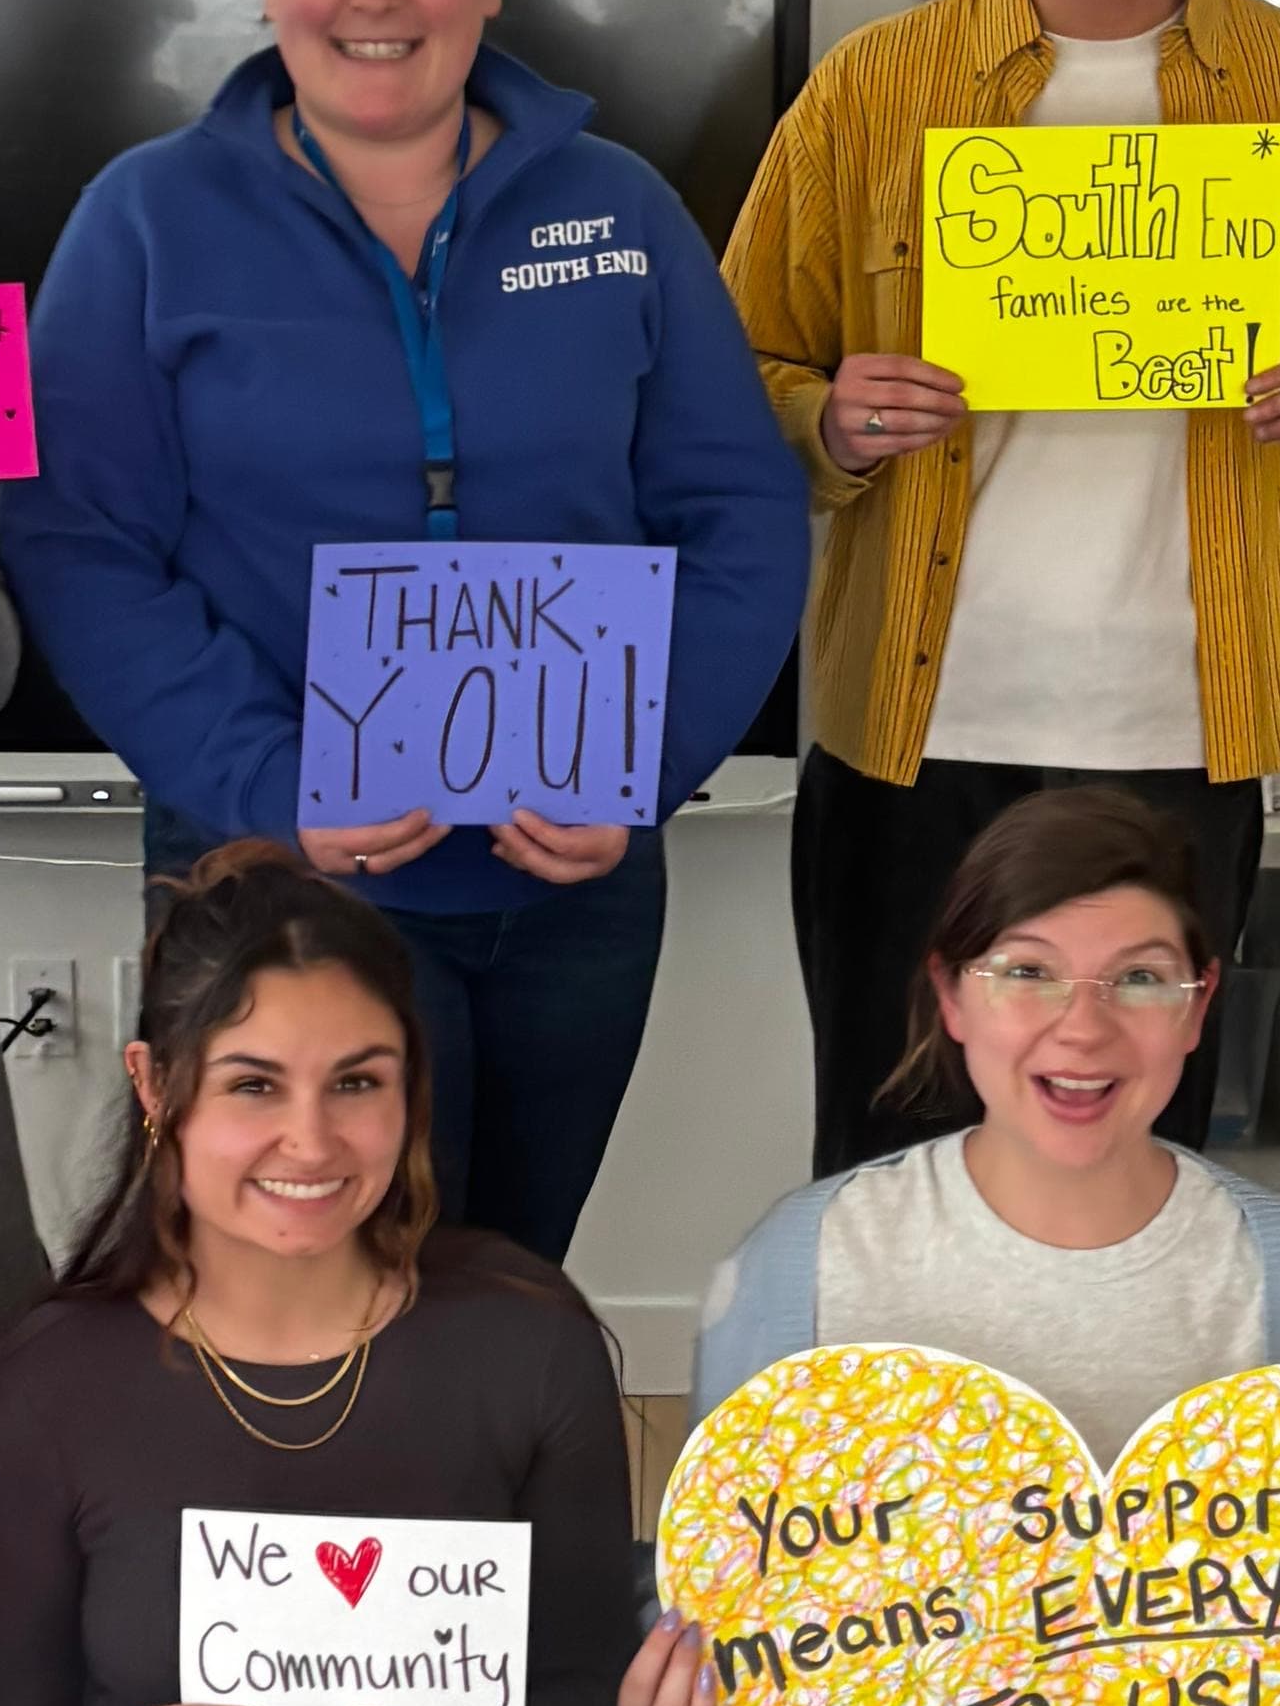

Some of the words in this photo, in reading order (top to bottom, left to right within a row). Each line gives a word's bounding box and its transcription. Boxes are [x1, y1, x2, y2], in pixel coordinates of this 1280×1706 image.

[531, 215, 615, 249] CROFT
[935, 133, 1180, 269] South
[501, 256, 591, 293] SOUTH
[594, 249, 648, 277] END
[1156, 296, 1192, 314] are
[1201, 294, 1245, 313] the
[1093, 322, 1262, 404] Best!
[339, 564, 584, 655] THANK
[310, 644, 636, 801] YOU!
[199, 1521, 292, 1587] We
[713, 1586, 967, 1695] means
